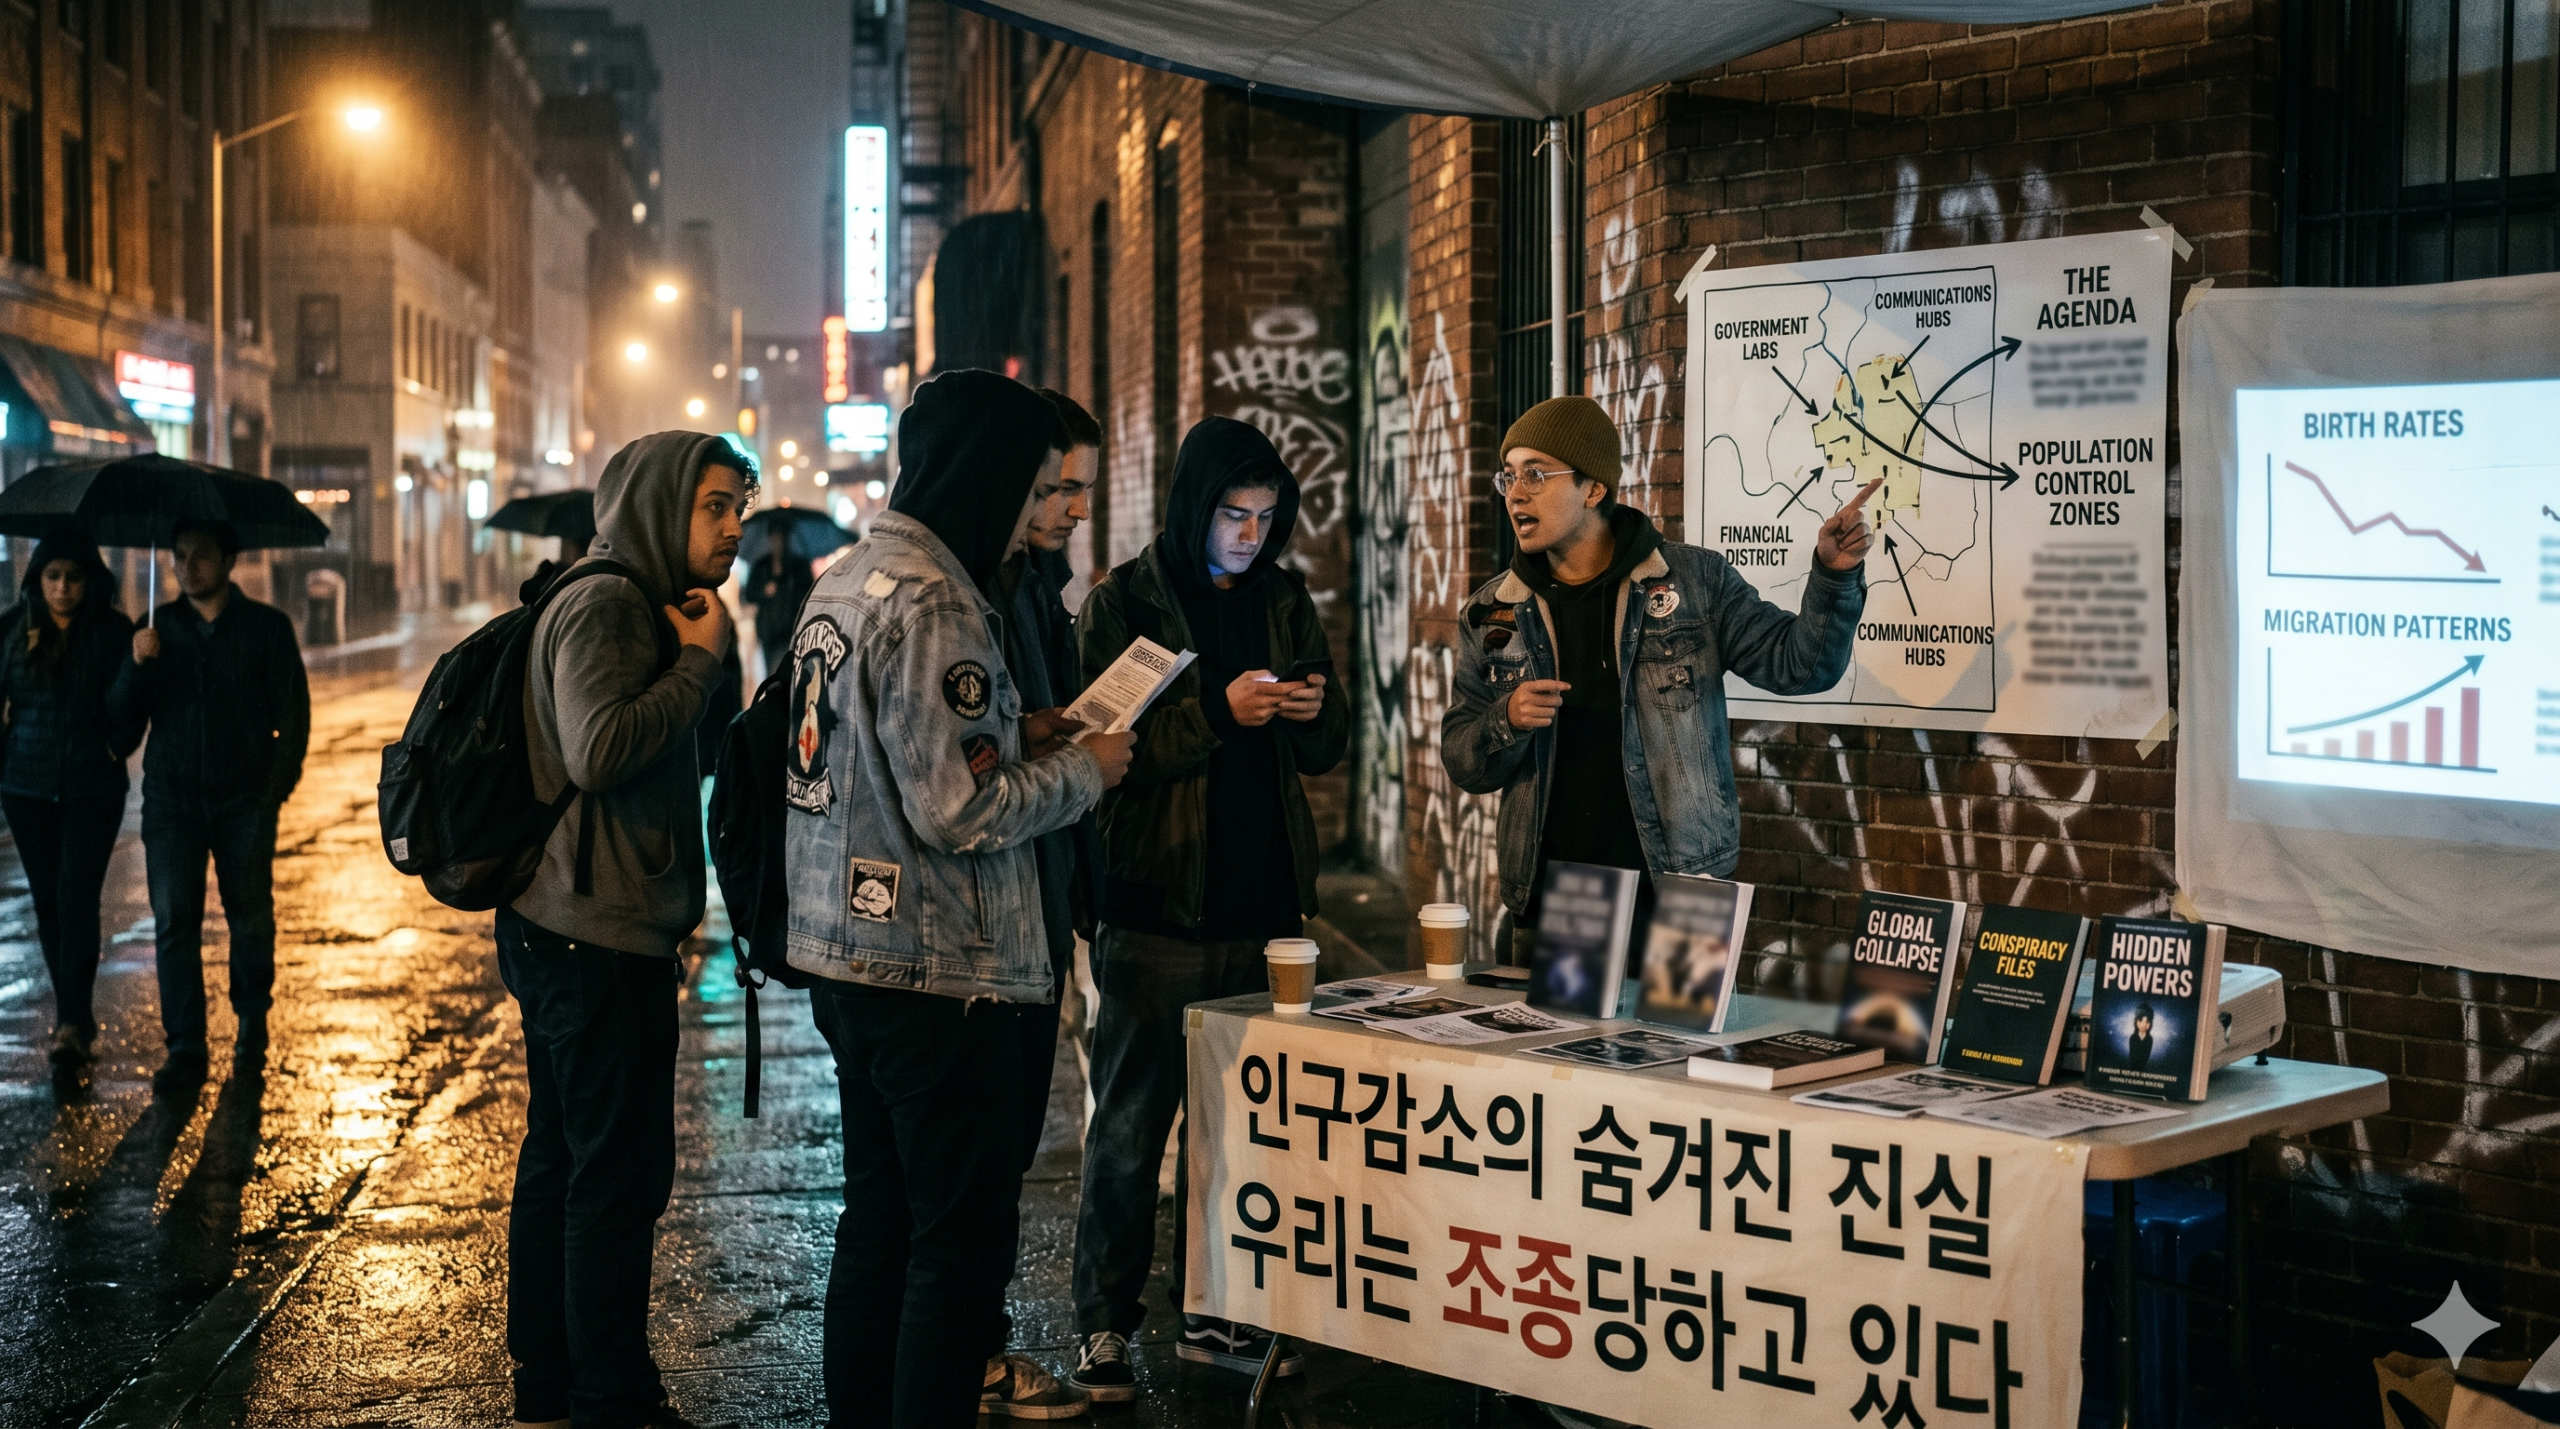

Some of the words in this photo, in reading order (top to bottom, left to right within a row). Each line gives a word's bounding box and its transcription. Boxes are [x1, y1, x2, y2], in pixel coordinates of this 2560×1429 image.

[2063, 265, 2111, 295] THE
[1875, 285, 1992, 310] COMMUNICATIONS
[1915, 310, 1951, 329] HUBS
[2037, 297, 2137, 330] AGENDA
[1714, 316, 1810, 341] GOVERNMENT
[1742, 341, 1779, 361] LABS
[2303, 411, 2375, 439] BIRTH
[2384, 408, 2465, 438] RATES
[2018, 437, 2154, 466] POPULATION
[2034, 470, 2135, 496] CONTROL
[2049, 500, 2120, 526] ZONES
[1719, 525, 1793, 544] FINANCIAL
[1726, 548, 1788, 567] DISTRICT
[1857, 622, 1994, 646] COMMUNICATIONS
[2264, 608, 2386, 638] MIGRATION
[2393, 614, 2512, 643] PATTERNS
[1904, 647, 1946, 667] HUBS
[1867, 909, 1935, 945] GLOBAL
[1854, 936, 1943, 974] COLLAPSE
[1979, 931, 2069, 963] CONSPIRACY
[2111, 931, 2192, 968] HIDDEN
[1996, 953, 2036, 980] FILES
[2103, 960, 2193, 998] POWERS
[1240, 1052, 1544, 1201] 인구감소의
[1573, 1104, 1793, 1243] 숨겨진
[1828, 1143, 1992, 1280] 진실
[1231, 1181, 1419, 1324] 우리는
[1442, 1225, 1817, 1397] 조종당하고
[1849, 1303, 2024, 1429] 있다
